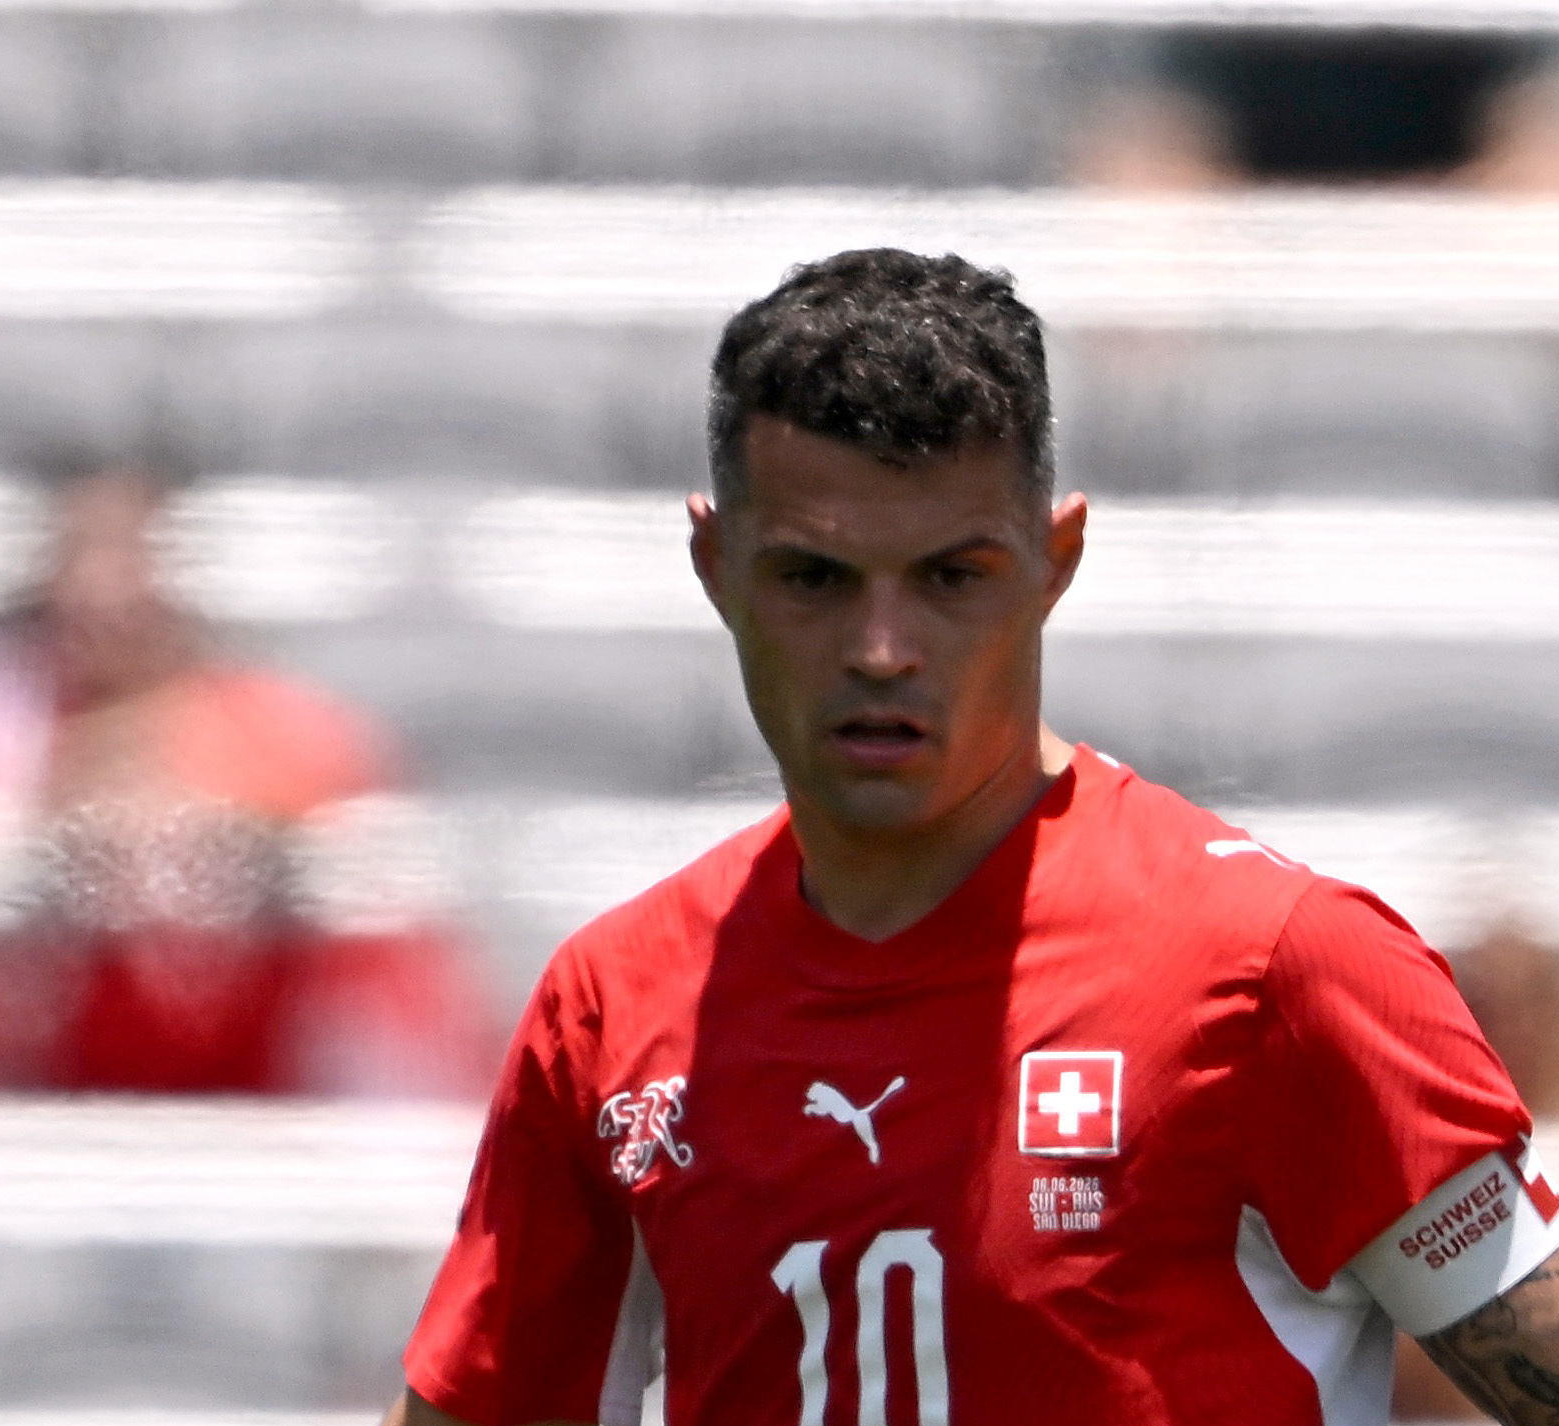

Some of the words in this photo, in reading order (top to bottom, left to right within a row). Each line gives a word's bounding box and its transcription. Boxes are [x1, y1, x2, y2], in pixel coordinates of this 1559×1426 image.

[1029, 1191, 1055, 1213] SUI
[1073, 1190, 1105, 1212] AUS
[1033, 1213, 1058, 1231] SAN
[1061, 1212, 1100, 1231] DIEGO
[1398, 1170, 1508, 1258] SCHWEIZ
[1424, 1197, 1512, 1270] SUISSE
